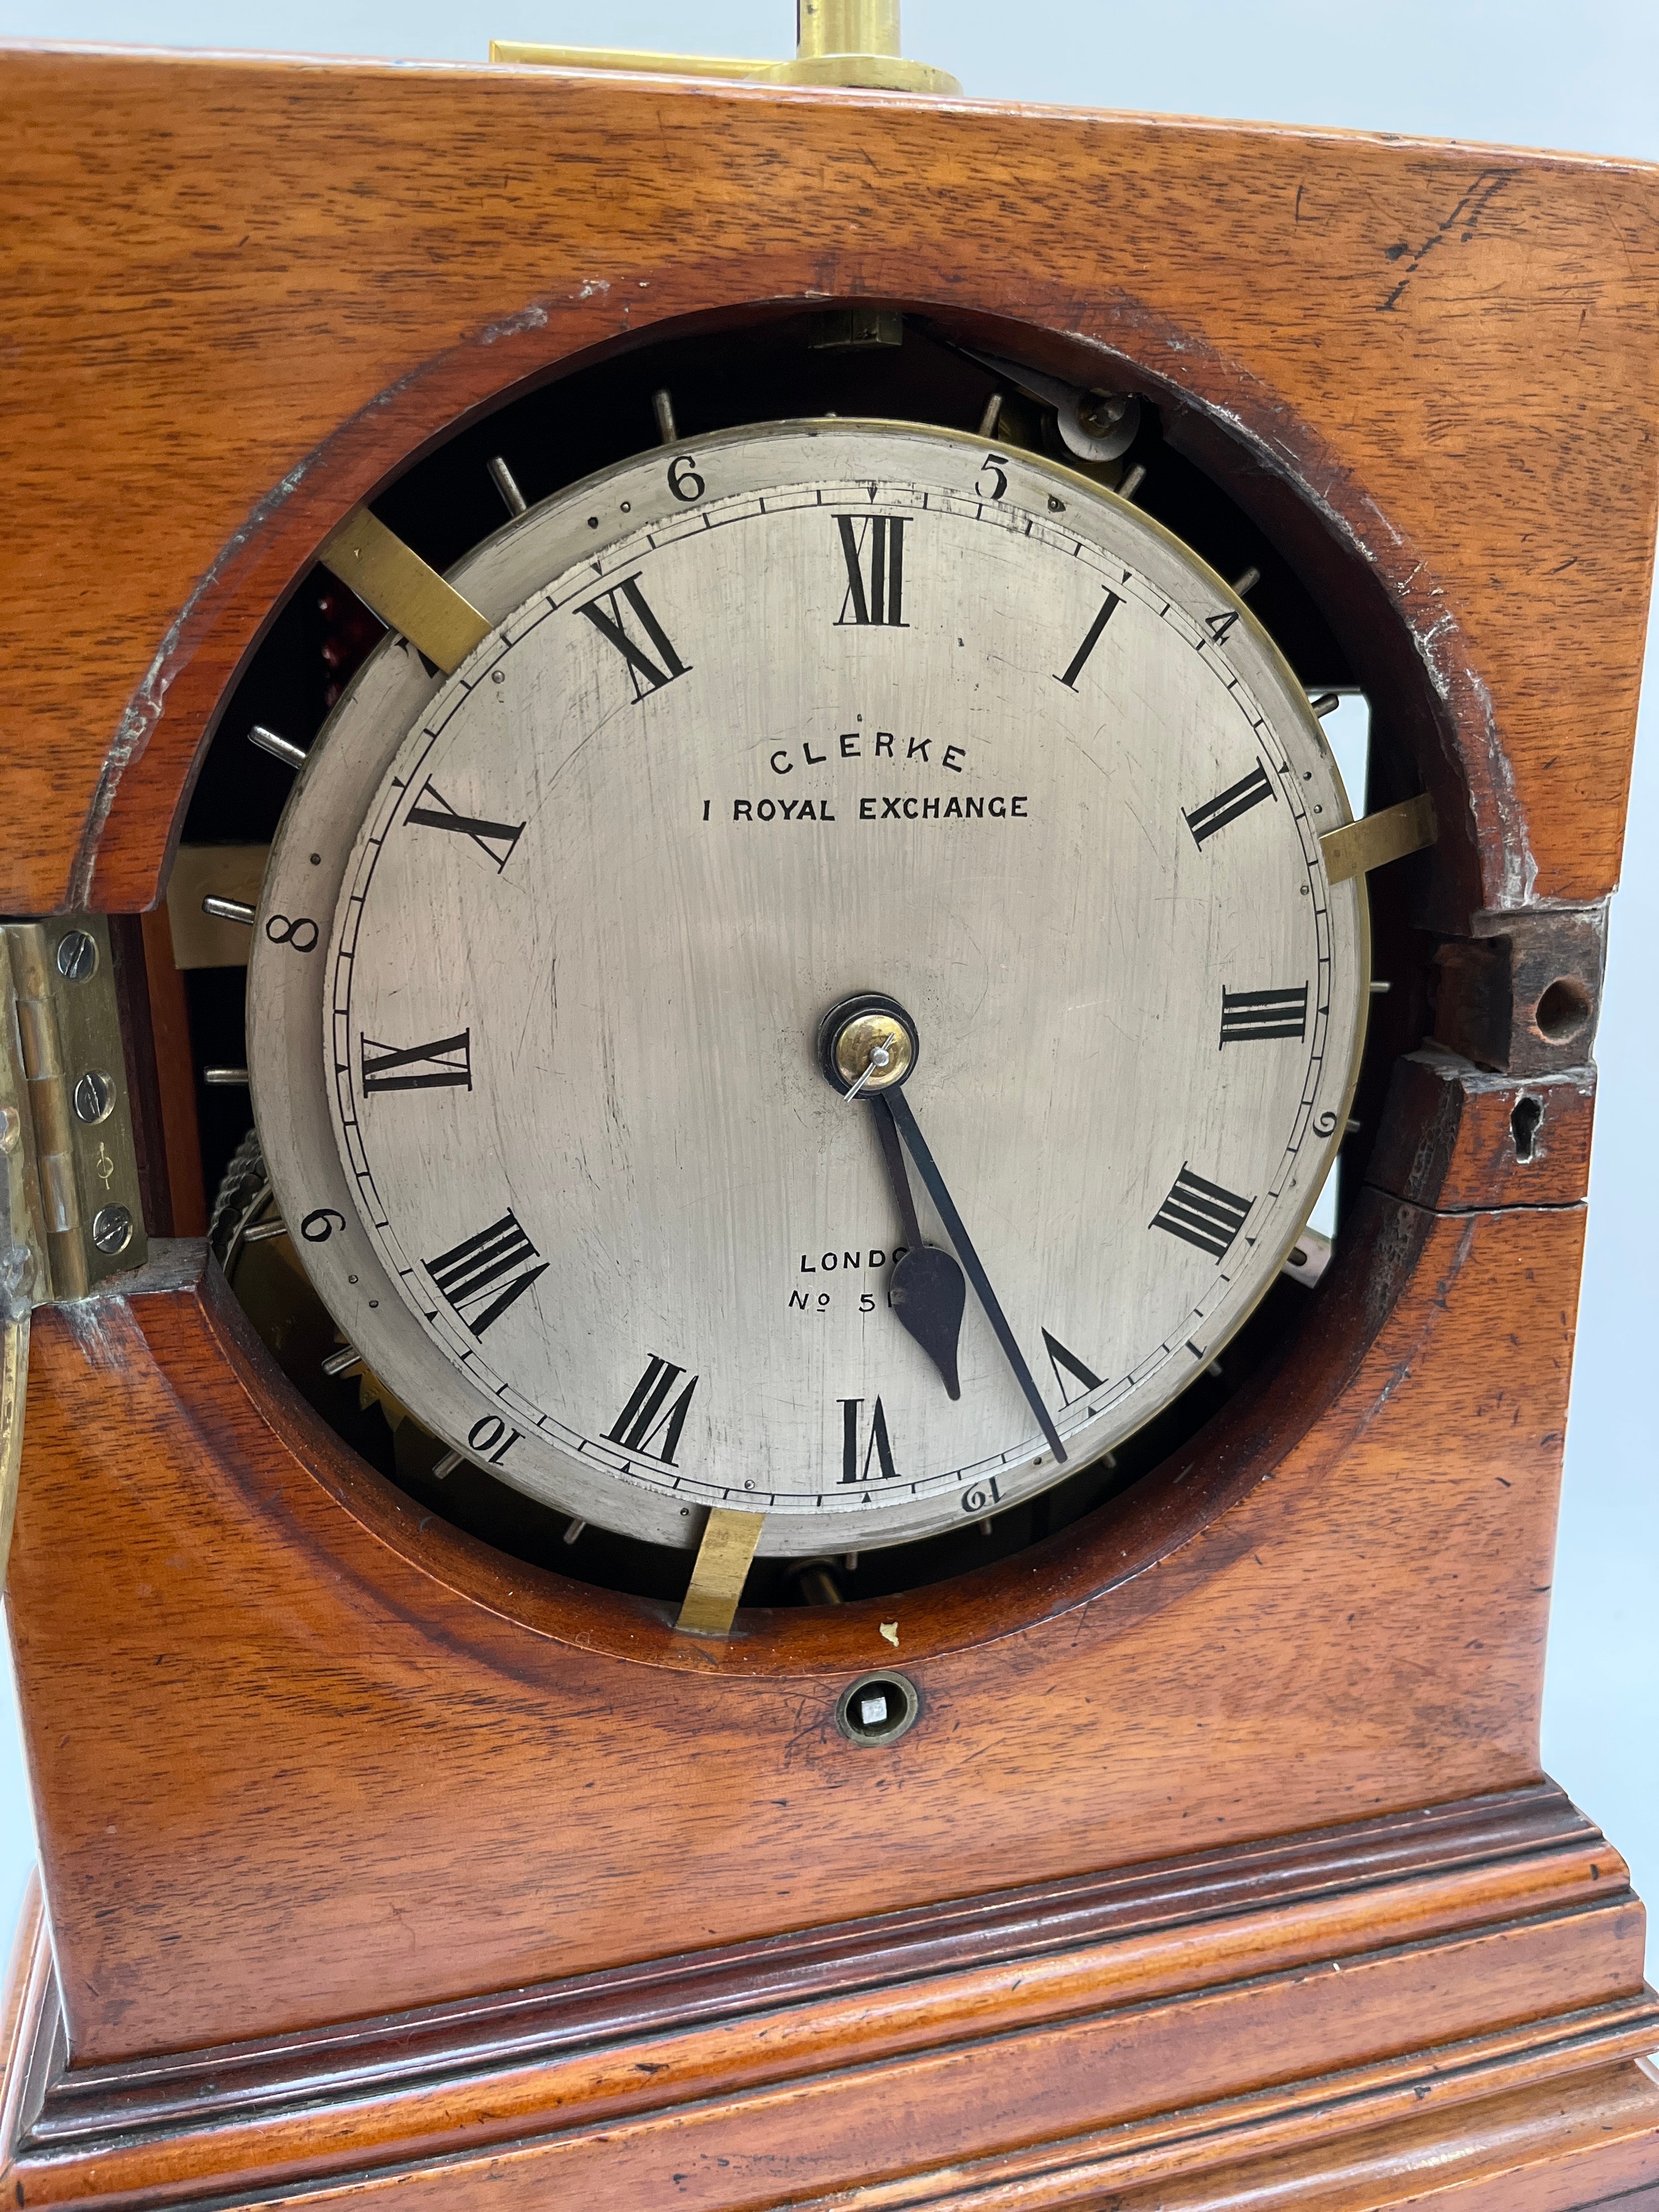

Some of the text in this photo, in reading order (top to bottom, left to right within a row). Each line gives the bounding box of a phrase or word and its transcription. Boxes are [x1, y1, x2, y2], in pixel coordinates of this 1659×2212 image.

[668, 456, 705, 502] 6
[975, 454, 1008, 500] 5
[831, 514, 913, 627] XII
[573, 571, 693, 705] XI
[1052, 585, 1126, 693] I
[1205, 611, 1239, 646] 4
[770, 732, 966, 774] CLERKE
[403, 774, 526, 874] X
[733, 799, 835, 821] ROYAL
[859, 796, 1027, 820] EXCHANGE
[1181, 756, 1277, 852] II
[266, 915, 319, 953] 8
[1219, 980, 1308, 1051] III
[360, 1027, 472, 1098] IX
[1148, 1161, 1257, 1266] IIII
[419, 1207, 550, 1344] VIII
[801, 1247, 908, 1272] LONDO
[1042, 1327, 1108, 1412] V
[468, 1415, 526, 1466] 10
[599, 1353, 699, 1467] VII
[837, 1395, 901, 1484] VI
